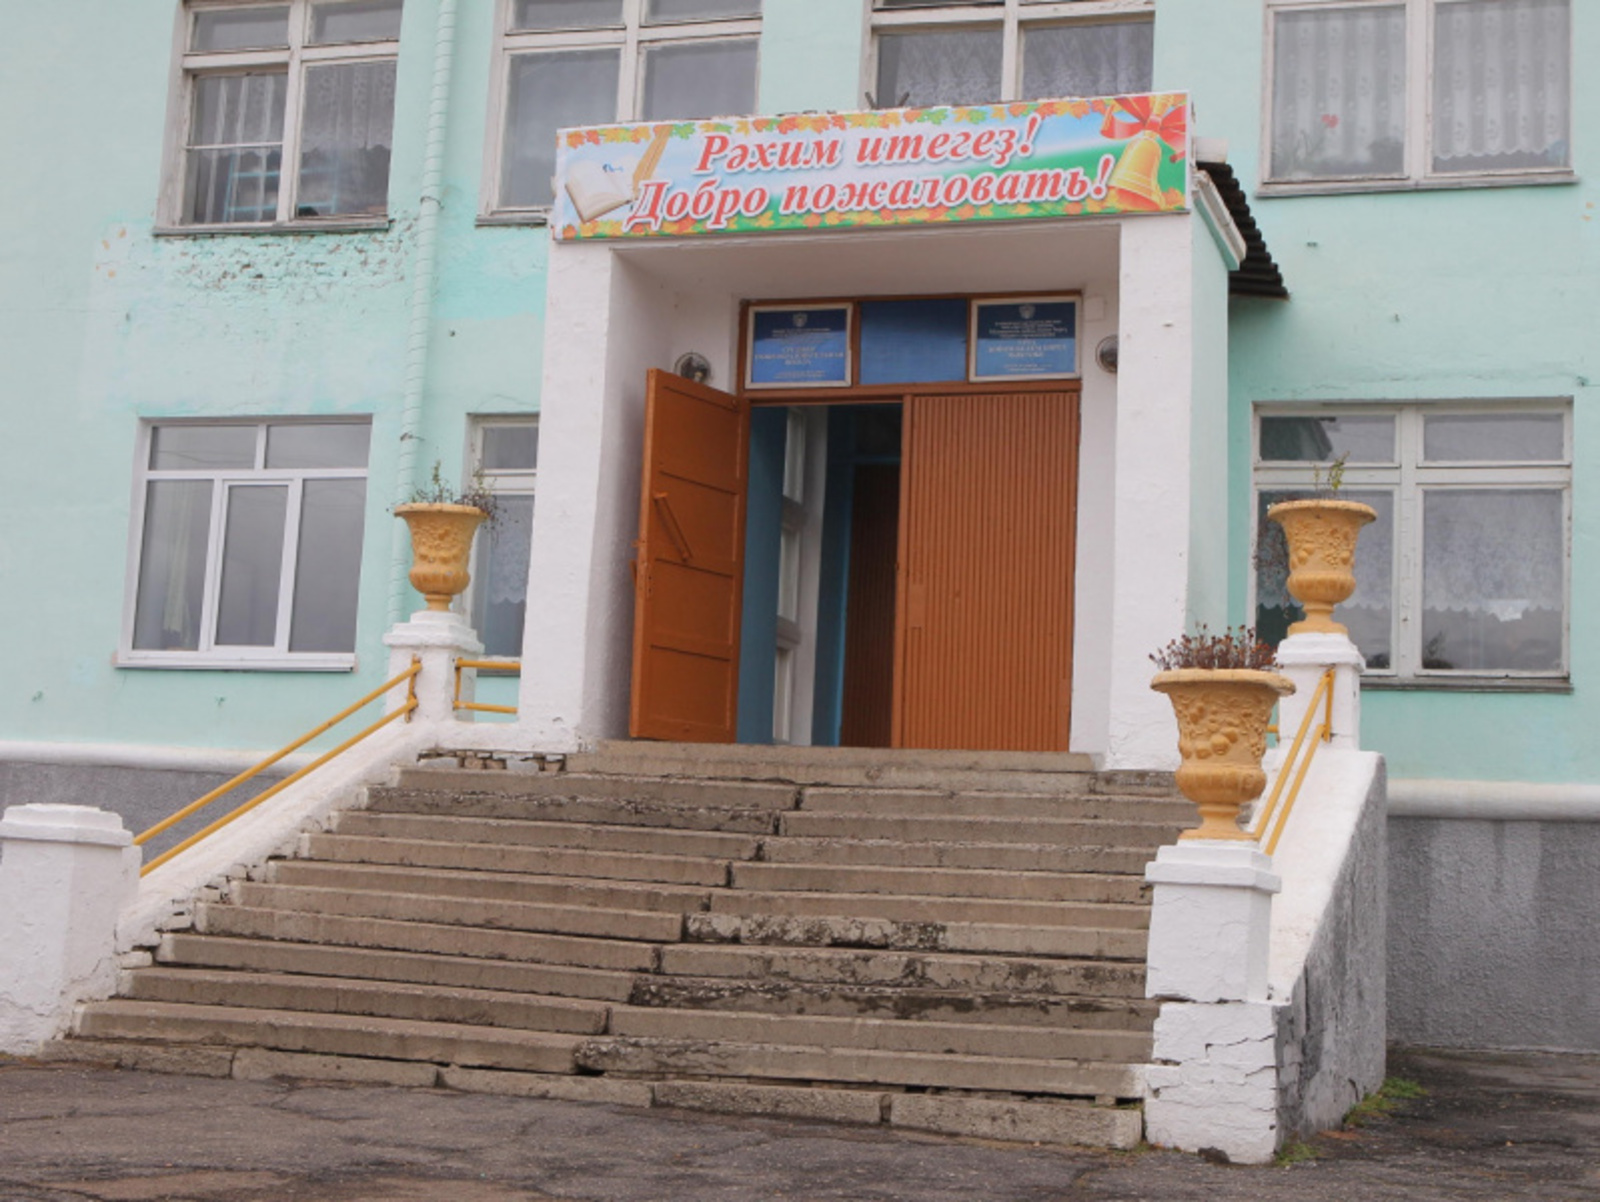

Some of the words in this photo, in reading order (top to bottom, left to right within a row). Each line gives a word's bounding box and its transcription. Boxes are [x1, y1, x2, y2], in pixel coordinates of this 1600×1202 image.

[694, 134, 840, 172] Рәхим
[624, 178, 768, 229] Добро
[781, 157, 1112, 212] пожаловать!
